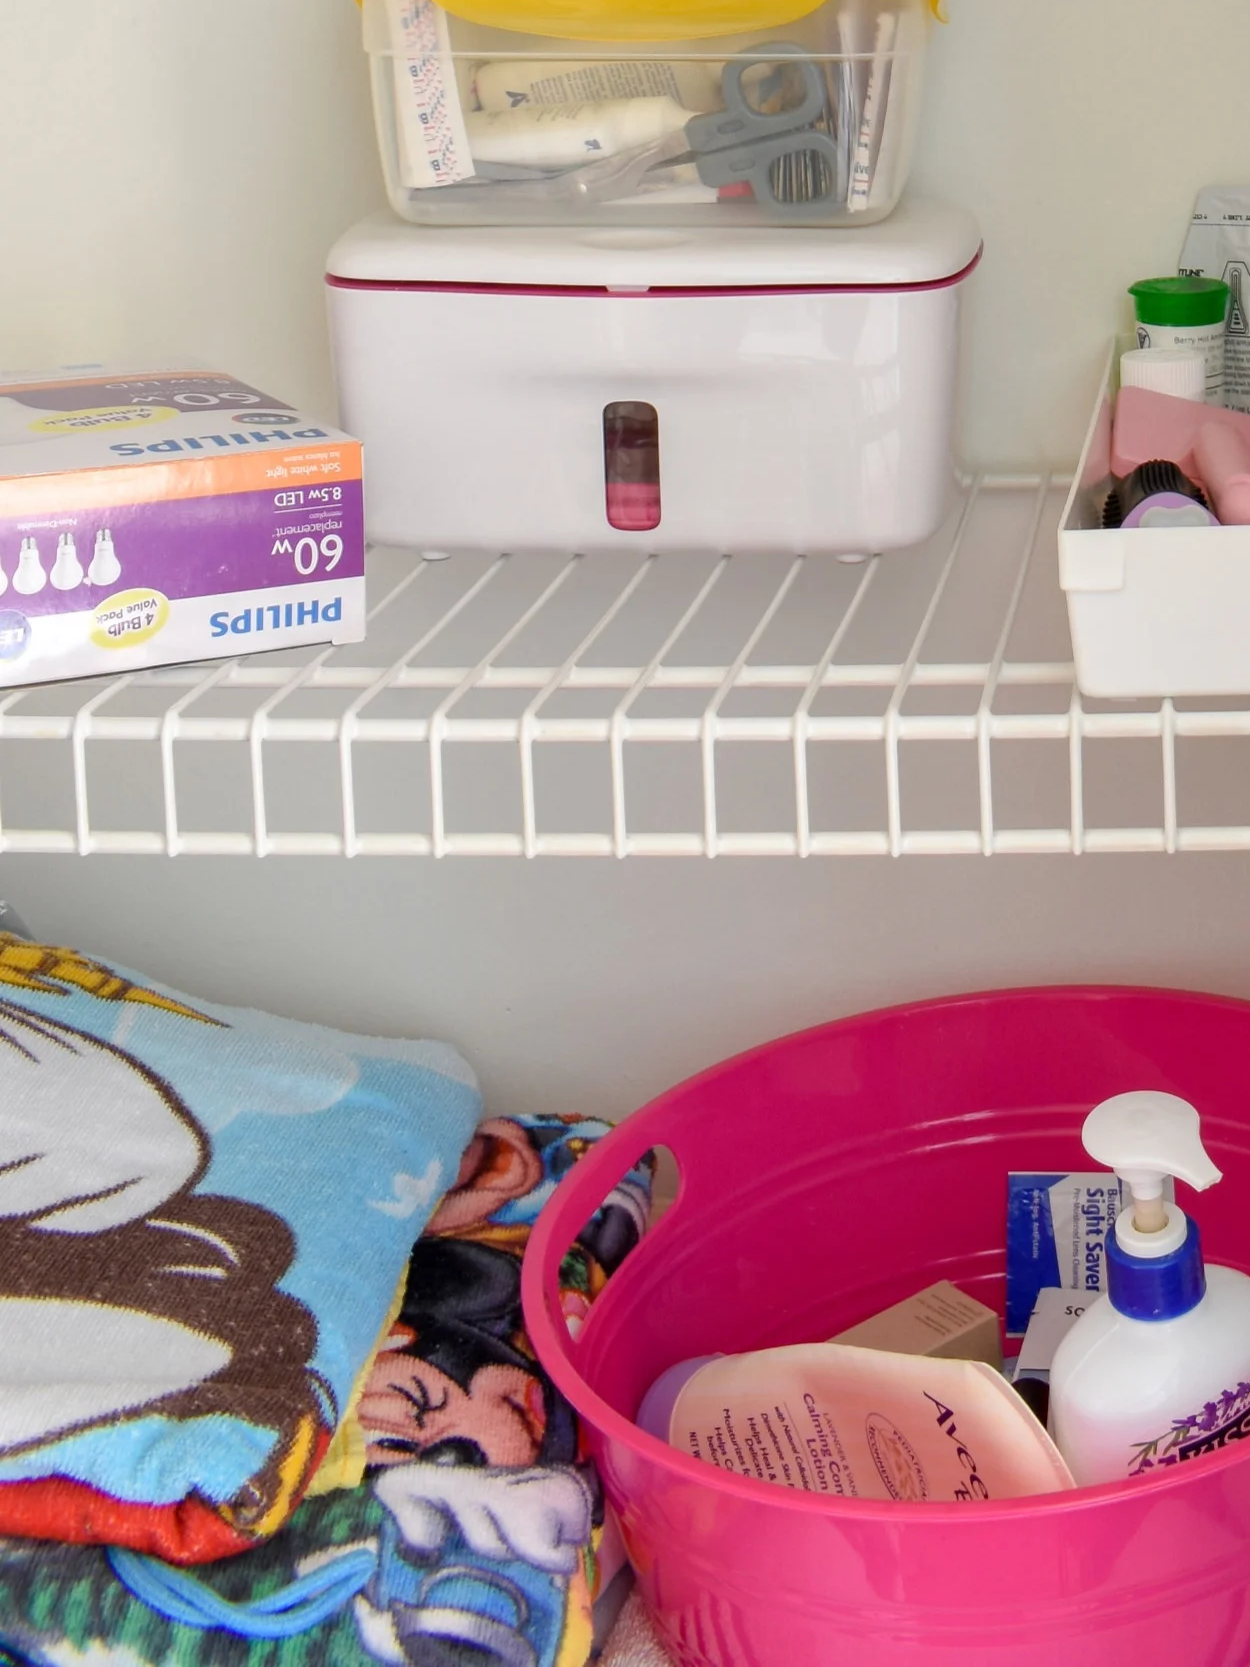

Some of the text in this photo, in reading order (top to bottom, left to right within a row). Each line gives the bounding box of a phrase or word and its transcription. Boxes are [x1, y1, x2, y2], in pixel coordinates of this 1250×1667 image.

[1174, 336, 1195, 345] Berry
[109, 429, 328, 456] PHILIPS
[266, 461, 341, 478] Soft white light
[274, 486, 342, 507] 8.5w LED
[273, 520, 343, 536] replacement
[95, 597, 157, 624] Value Pack
[107, 611, 155, 637] 4 Bulb
[209, 596, 342, 637] PHILIPS
[1107, 1188, 1118, 1228] Bausc
[1081, 1187, 1107, 1293] Sight Saver
[689, 1431, 699, 1447] NET
[714, 1426, 727, 1456] Helps
[723, 1409, 746, 1466] Moisturizes
[747, 1417, 762, 1446] Helps
[760, 1447, 775, 1471] Heal
[774, 1406, 785, 1423] with
[782, 1424, 799, 1455] Natural
[803, 1393, 832, 1457] Calming
[823, 1412, 847, 1463] LAVENDER
[706, 1435, 721, 1467] befor
[745, 1438, 764, 1479] Delicate
[760, 1412, 794, 1481] Dimethicone Skin
[806, 1438, 829, 1491] Lotion
[923, 1391, 988, 1500] Avee
